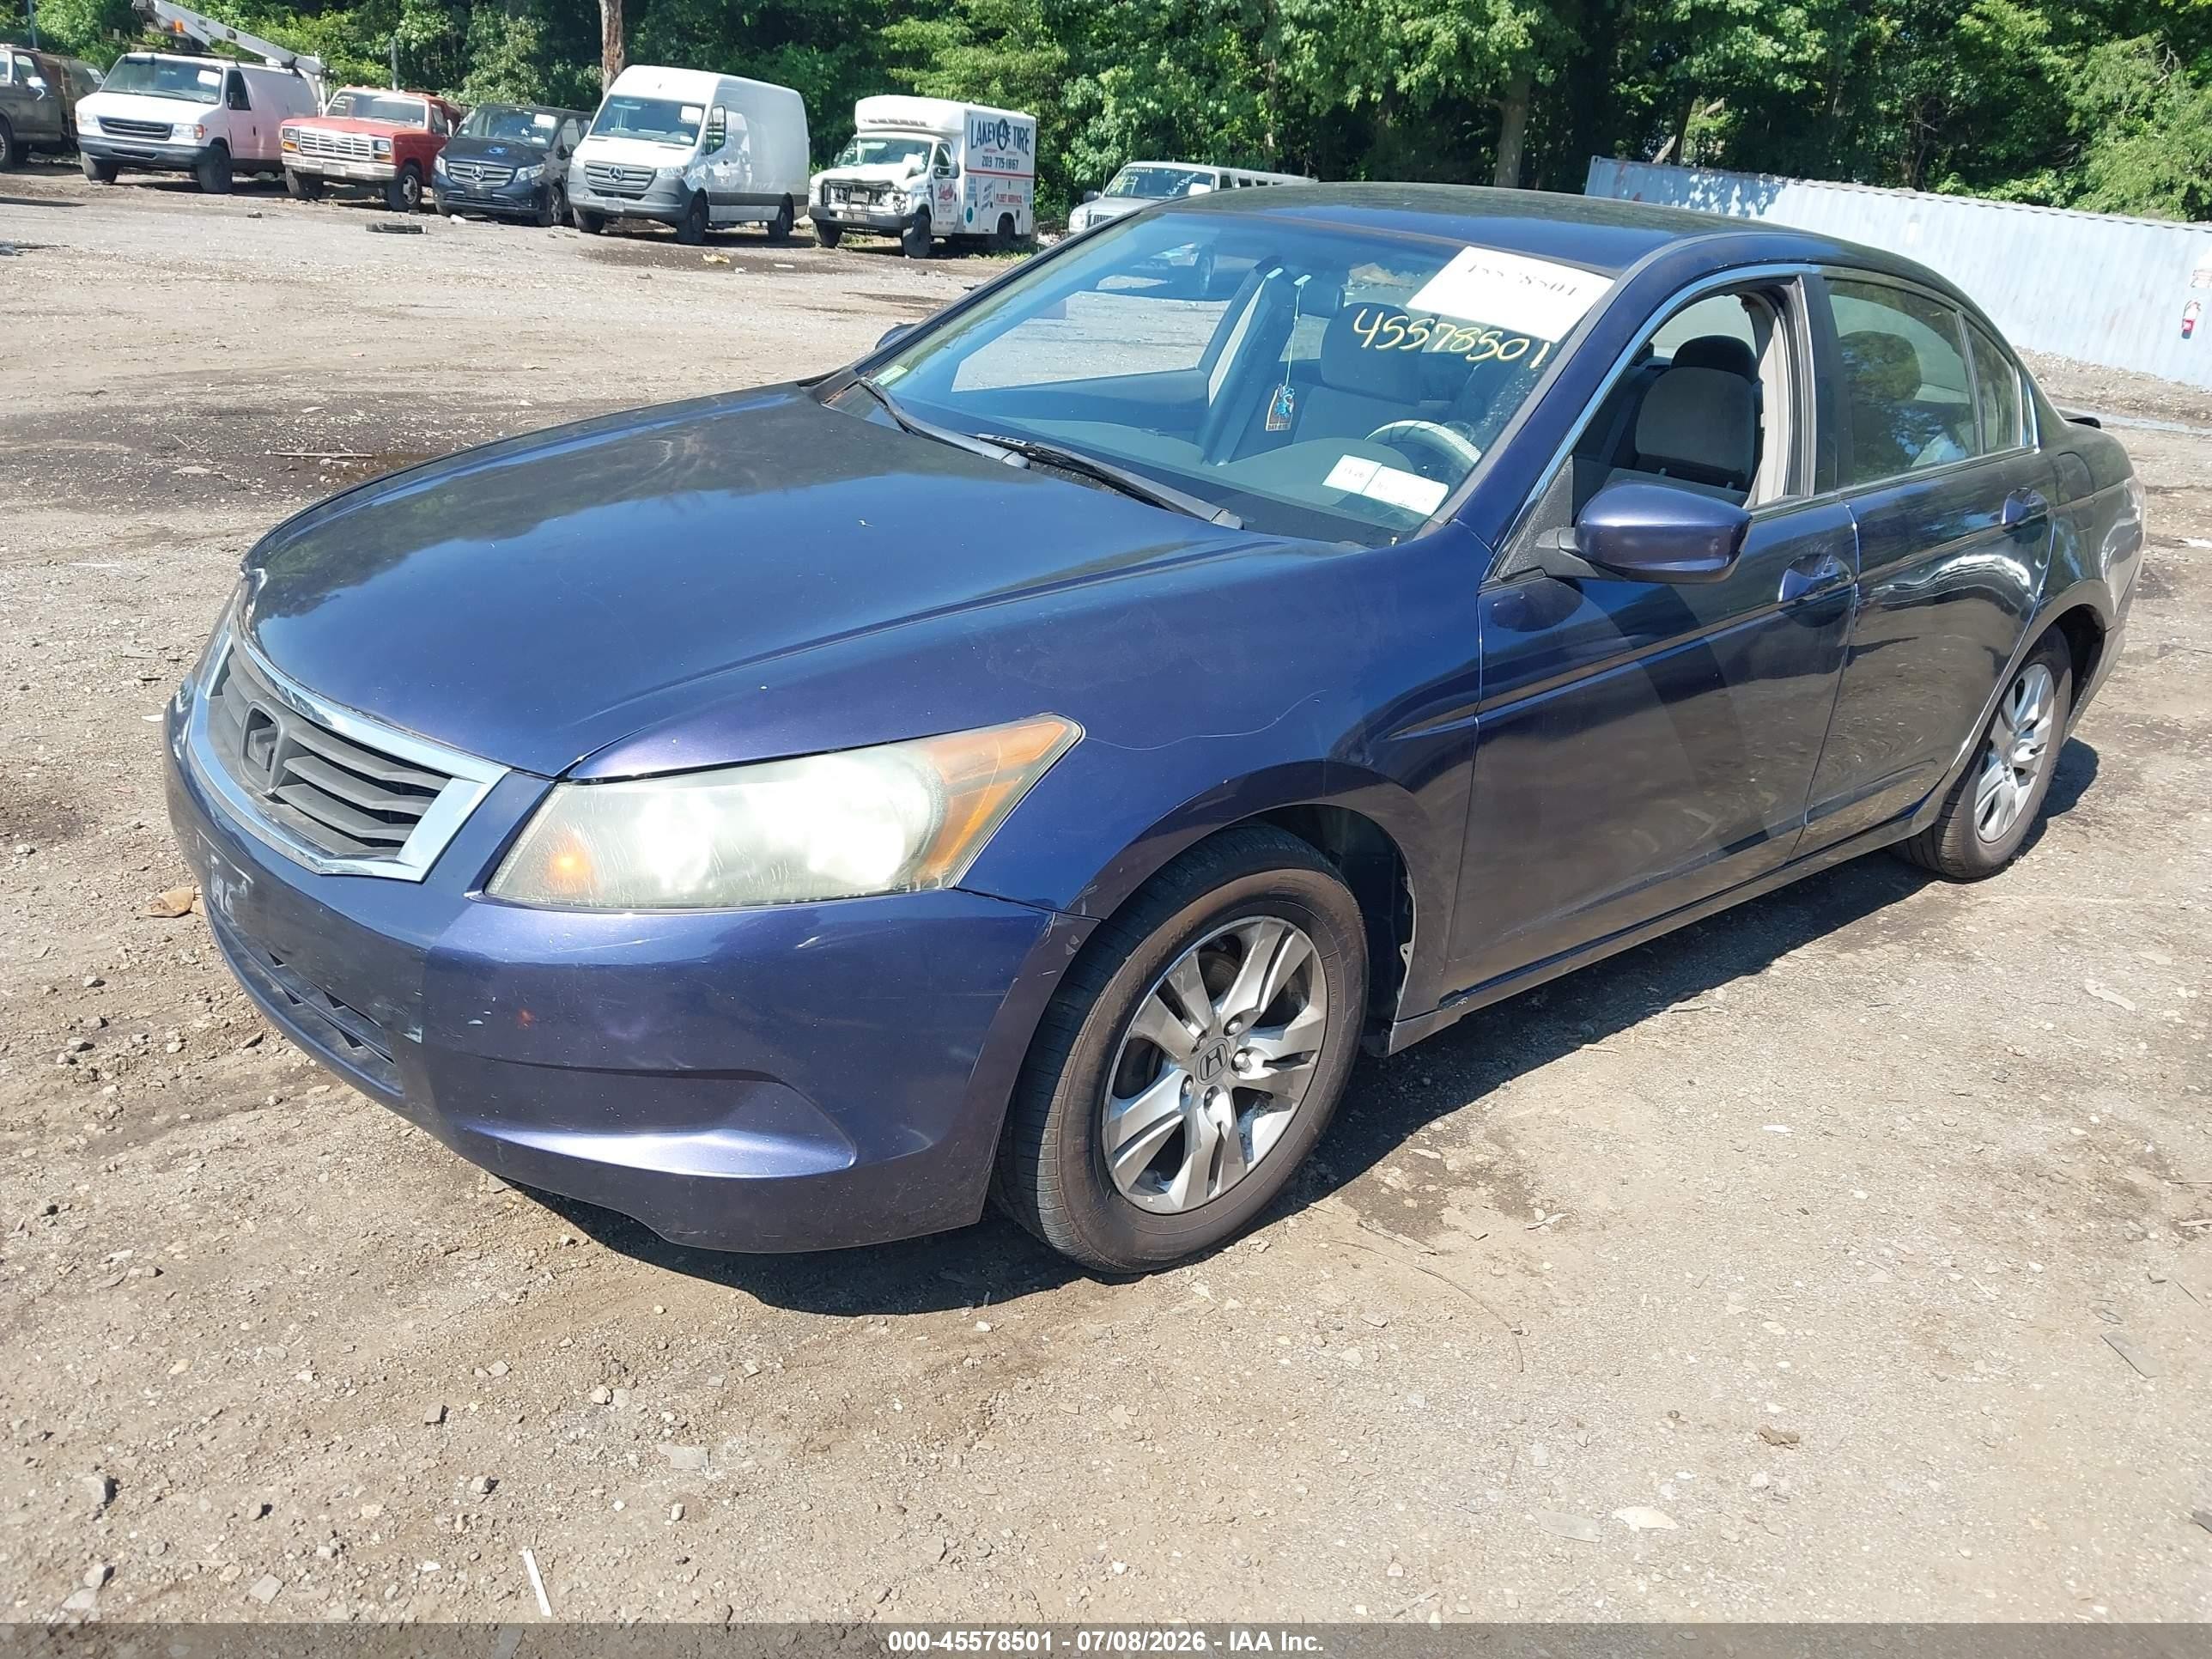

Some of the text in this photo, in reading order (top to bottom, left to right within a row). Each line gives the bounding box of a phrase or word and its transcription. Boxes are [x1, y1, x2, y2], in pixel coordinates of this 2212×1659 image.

[1013, 125, 1030, 156] TIRE
[981, 155, 993, 167] 203
[995, 156, 1005, 169] 775
[1353, 308, 1551, 369] 45578501
